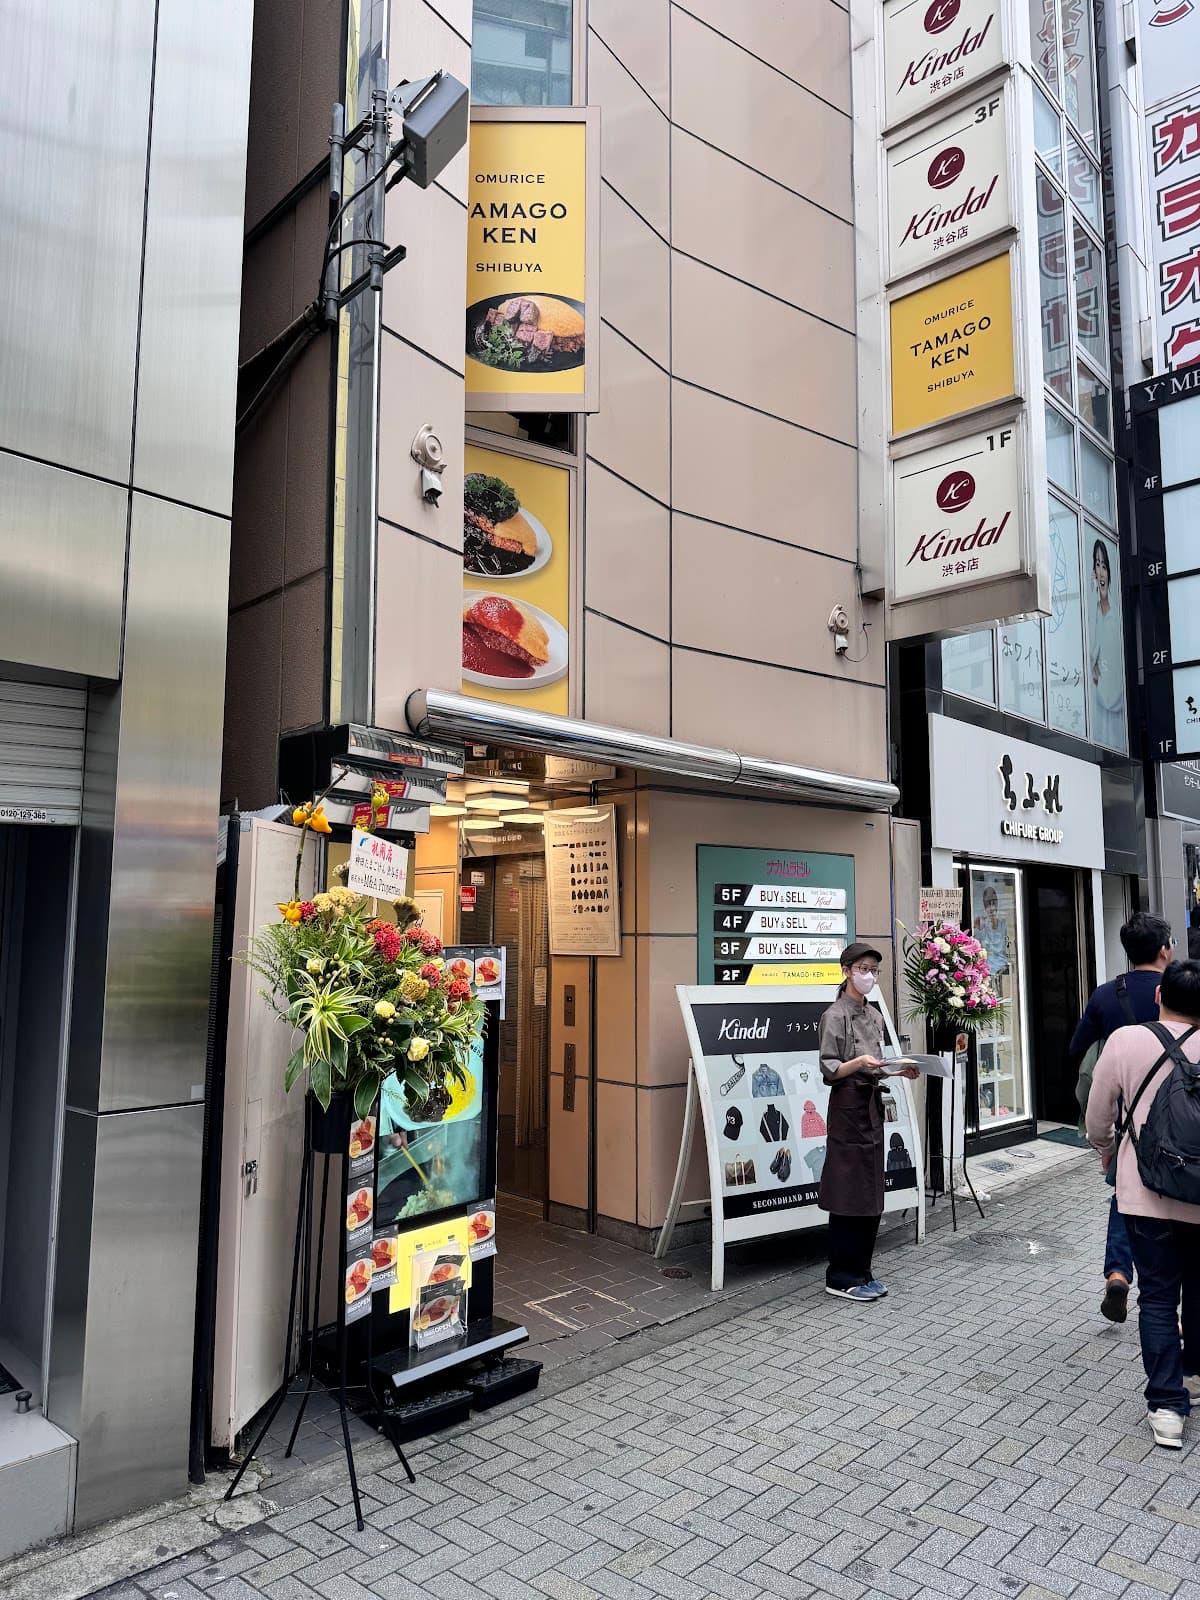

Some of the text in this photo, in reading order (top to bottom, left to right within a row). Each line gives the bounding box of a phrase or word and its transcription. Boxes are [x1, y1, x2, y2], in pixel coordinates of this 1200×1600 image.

[896, 14, 994, 95] Kindal
[929, 66, 965, 95] 渋谷店
[974, 98, 1001, 126] 3F
[474, 173, 546, 185] OMURICE
[467, 202, 568, 220] AMAGO
[898, 175, 998, 248] Kindal
[482, 227, 537, 244] KEN
[932, 225, 969, 251] 渋谷店
[475, 262, 543, 274] SHIBUYA
[924, 299, 975, 326] OMURICE
[910, 316, 992, 357] TAMAGO
[930, 343, 970, 369] KEN
[927, 369, 975, 393] SHIBUYA
[986, 430, 1012, 452] 1F
[1144, 475, 1159, 491] 4F
[905, 511, 1011, 566] Kindal
[942, 557, 980, 577] 渋谷店
[1147, 562, 1163, 577] 3F
[1152, 650, 1168, 665] 2F
[1158, 739, 1173, 753] 1F
[0, 808, 47, 820] 0120-129-365
[1002, 820, 1064, 844] CHIFURE GROUP
[721, 888, 741, 902] 5F
[760, 890, 780, 902] BUY
[785, 891, 808, 904] SELL
[722, 915, 743, 929] 4F
[760, 917, 780, 929] BUY
[786, 917, 808, 929] SELL
[720, 942, 740, 955] 3F
[758, 943, 778, 955] BUY
[784, 943, 807, 955] SELL
[722, 970, 741, 981] 2F
[718, 1017, 770, 1040] Kindal
[752, 1194, 803, 1209] SECONDHAND
